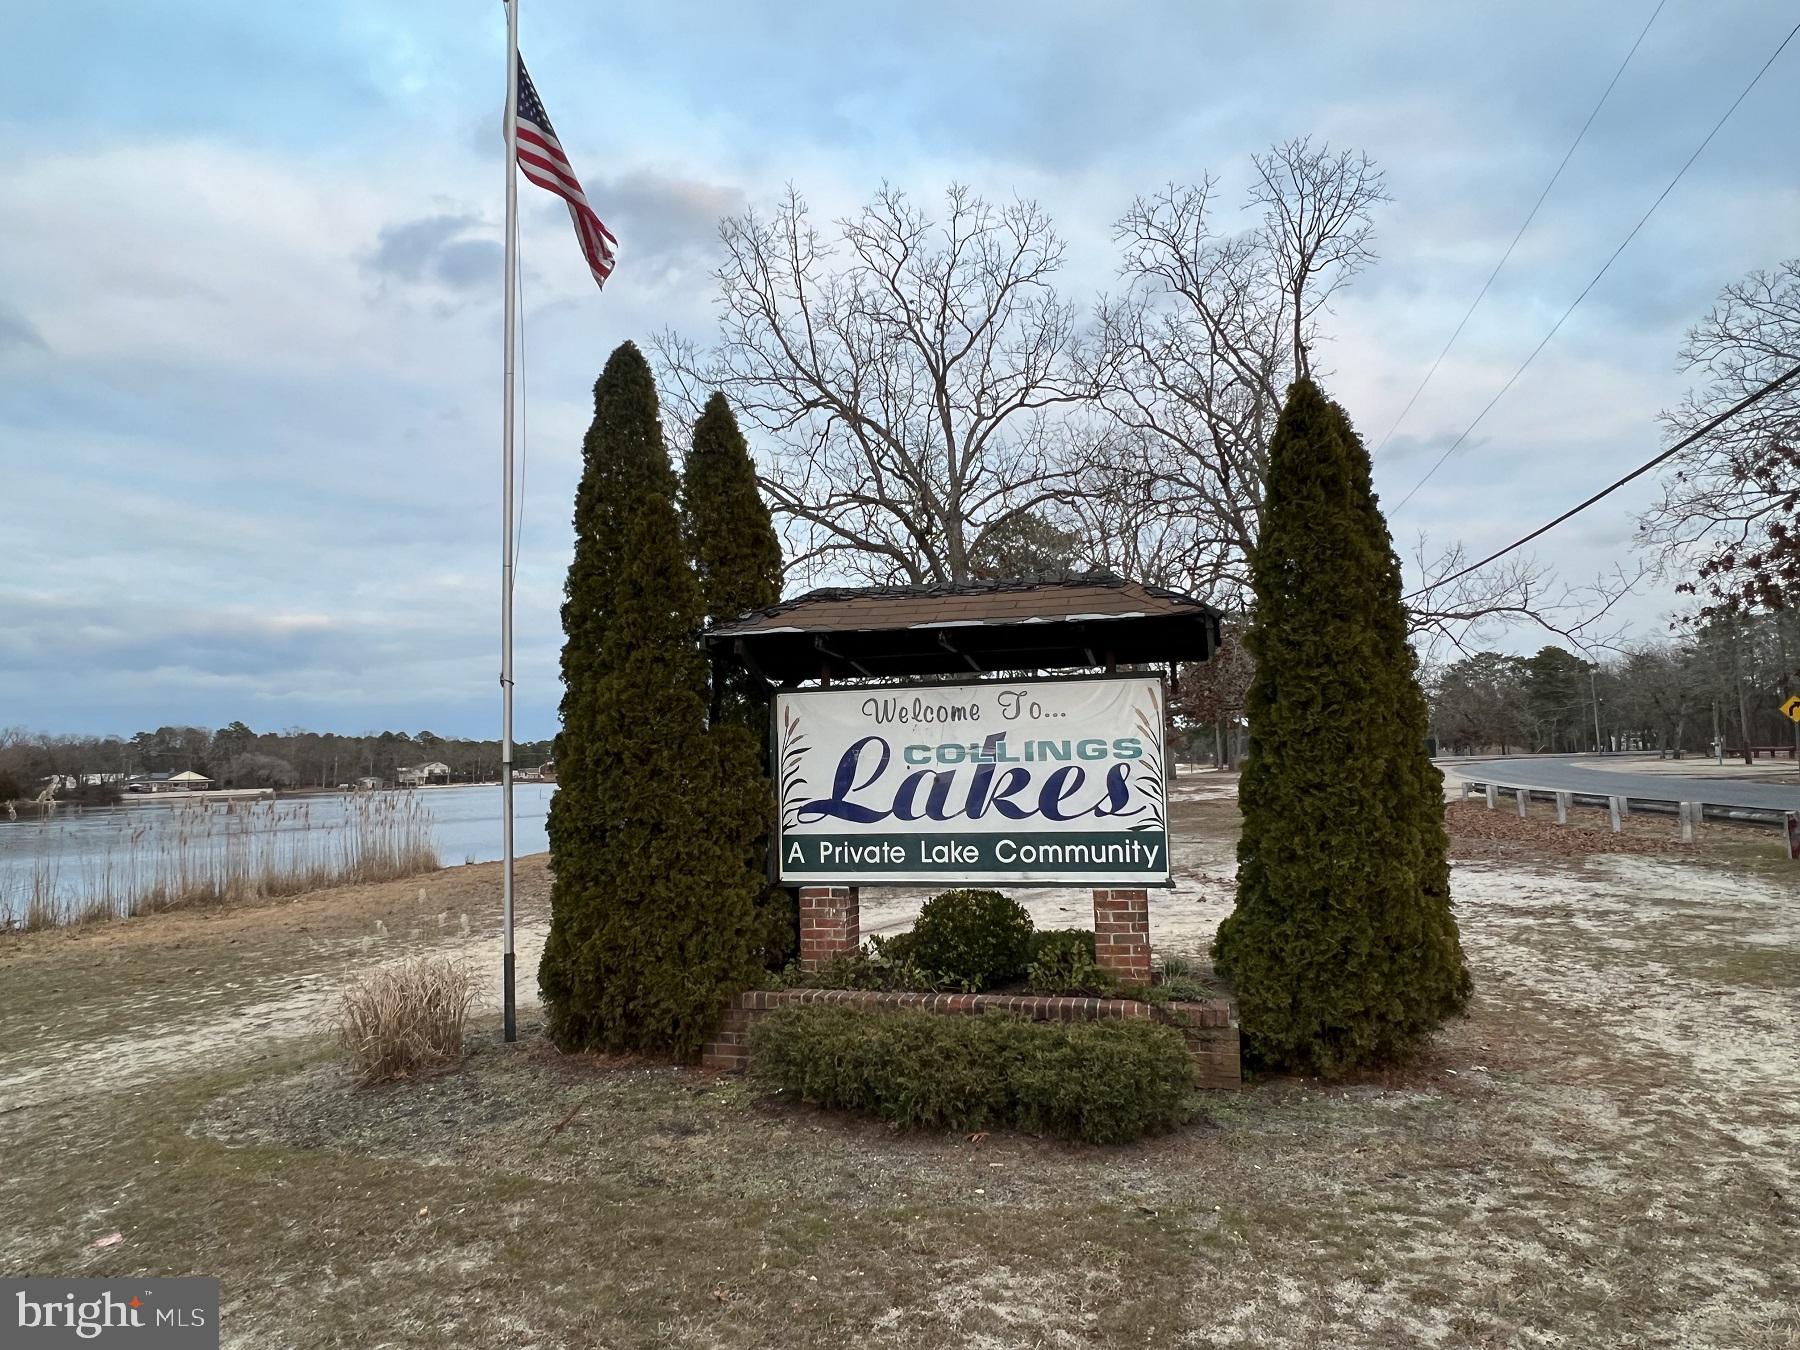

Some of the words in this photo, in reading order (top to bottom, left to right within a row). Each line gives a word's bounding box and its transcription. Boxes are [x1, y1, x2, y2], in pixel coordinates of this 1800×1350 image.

[862, 697, 980, 725] Welcome
[997, 690, 1066, 721] To...
[903, 737, 1143, 765] COLLINGS
[797, 730, 1147, 824] Lakes
[787, 845, 805, 864] A
[820, 841, 906, 864] Private
[921, 840, 979, 863] Lake
[995, 839, 1159, 868] Community
